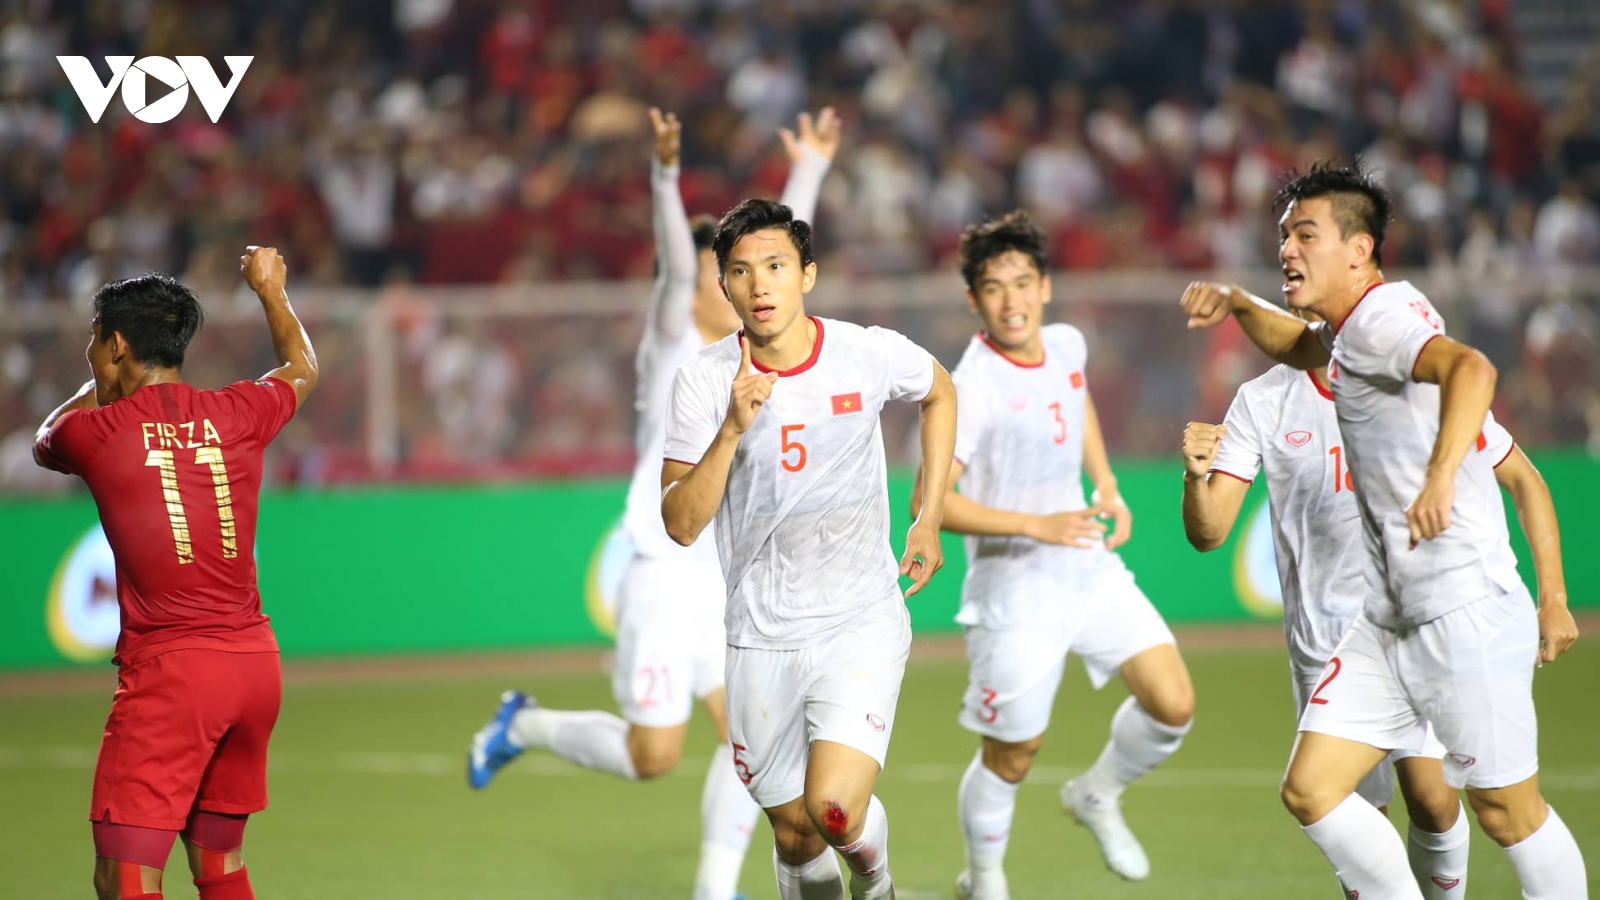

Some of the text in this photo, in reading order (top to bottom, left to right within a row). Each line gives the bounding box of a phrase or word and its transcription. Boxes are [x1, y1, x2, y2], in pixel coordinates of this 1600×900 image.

[141, 418, 222, 450] FIRZA
[1047, 402, 1067, 445] 3
[781, 424, 807, 472] 5
[144, 446, 238, 565] 11
[637, 666, 673, 708] 21
[1310, 656, 1342, 705] 2
[976, 687, 998, 724] 3
[733, 743, 753, 784] 5
